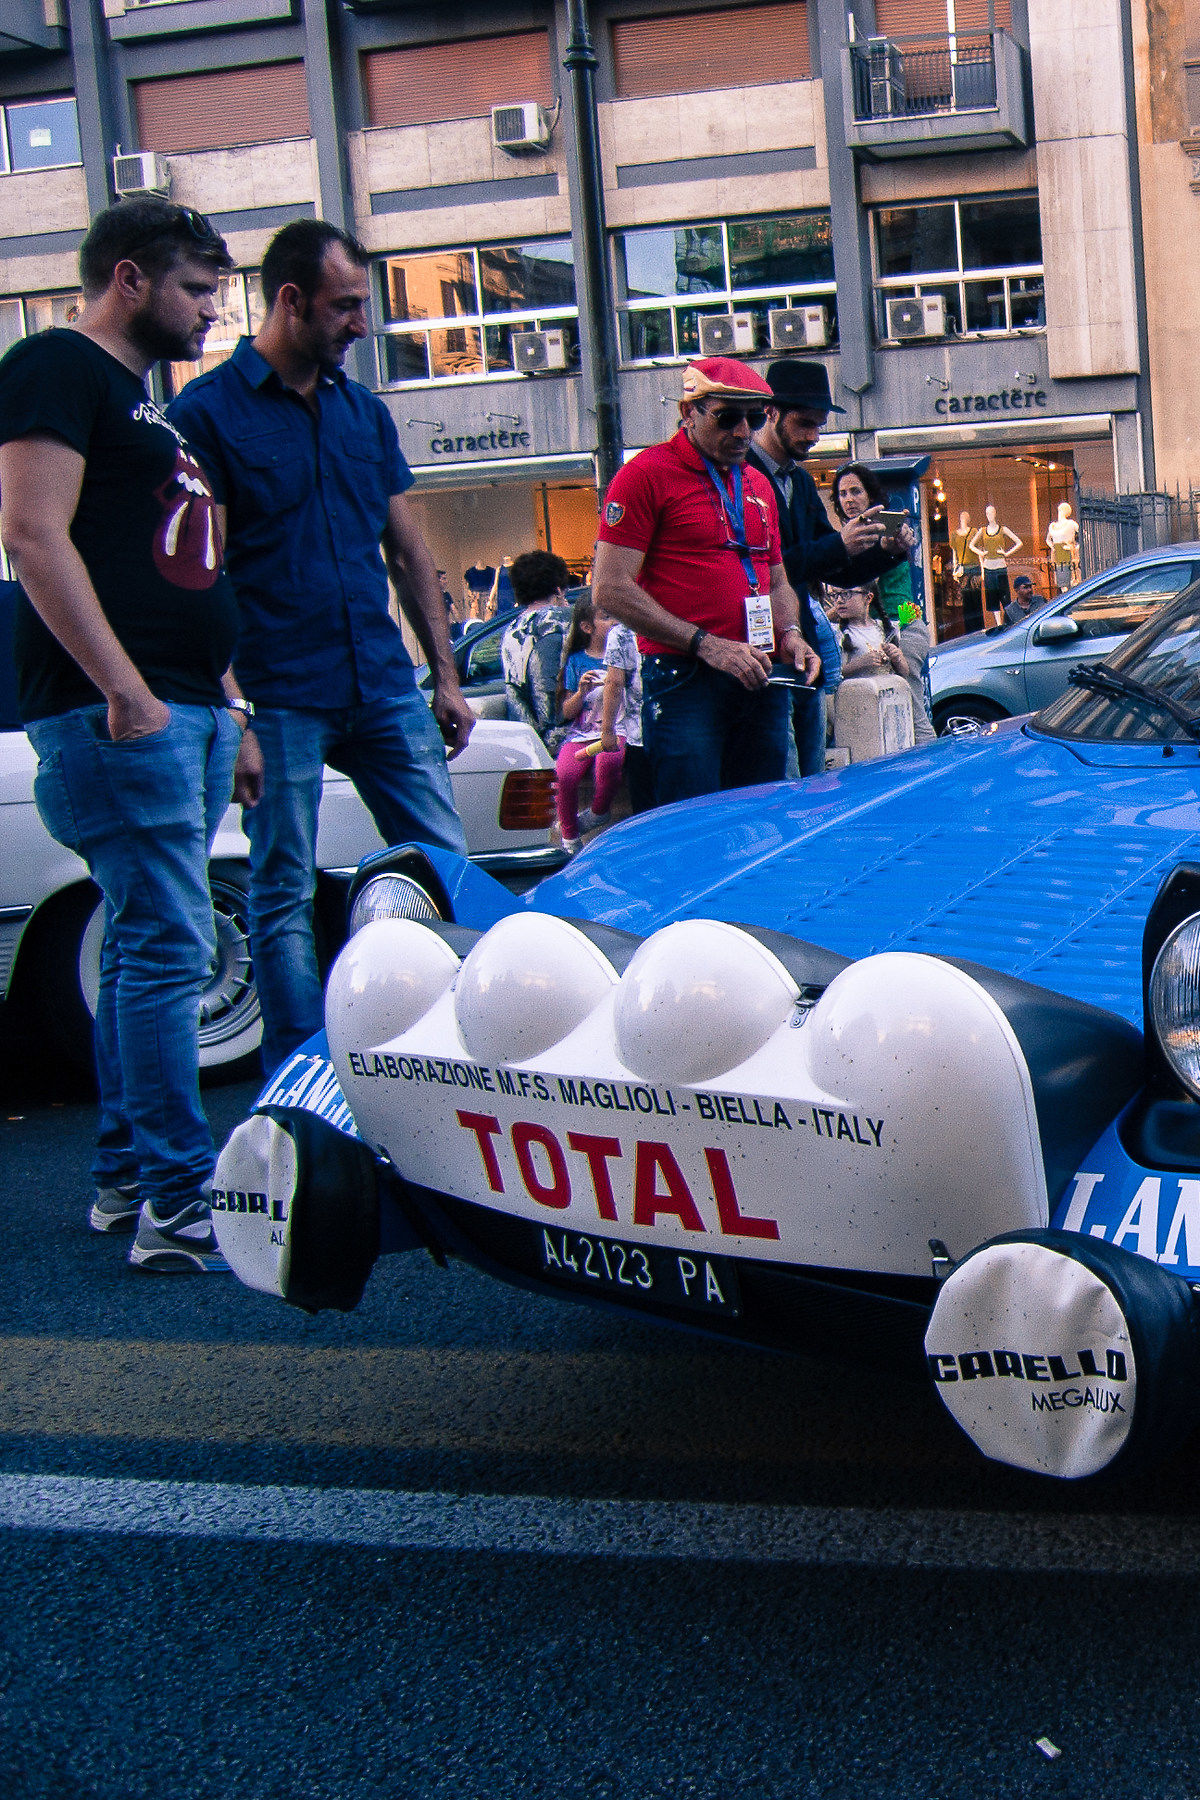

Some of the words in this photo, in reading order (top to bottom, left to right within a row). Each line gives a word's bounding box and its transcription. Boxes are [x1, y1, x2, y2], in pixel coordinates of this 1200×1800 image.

[349, 1052, 496, 1092] ELABORAZIONE
[499, 1069, 557, 1102] M.F.S.
[558, 1078, 677, 1116] MAGLIOLI
[695, 1093, 793, 1130] BIELLA
[811, 1107, 885, 1147] ITALY
[456, 1109, 781, 1240] TOTAL
[543, 1229, 652, 1289] A42123
[678, 1255, 725, 1303] PA
[928, 1348, 1128, 1382] CARELLO
[1031, 1386, 1127, 1413] MEGALUX
